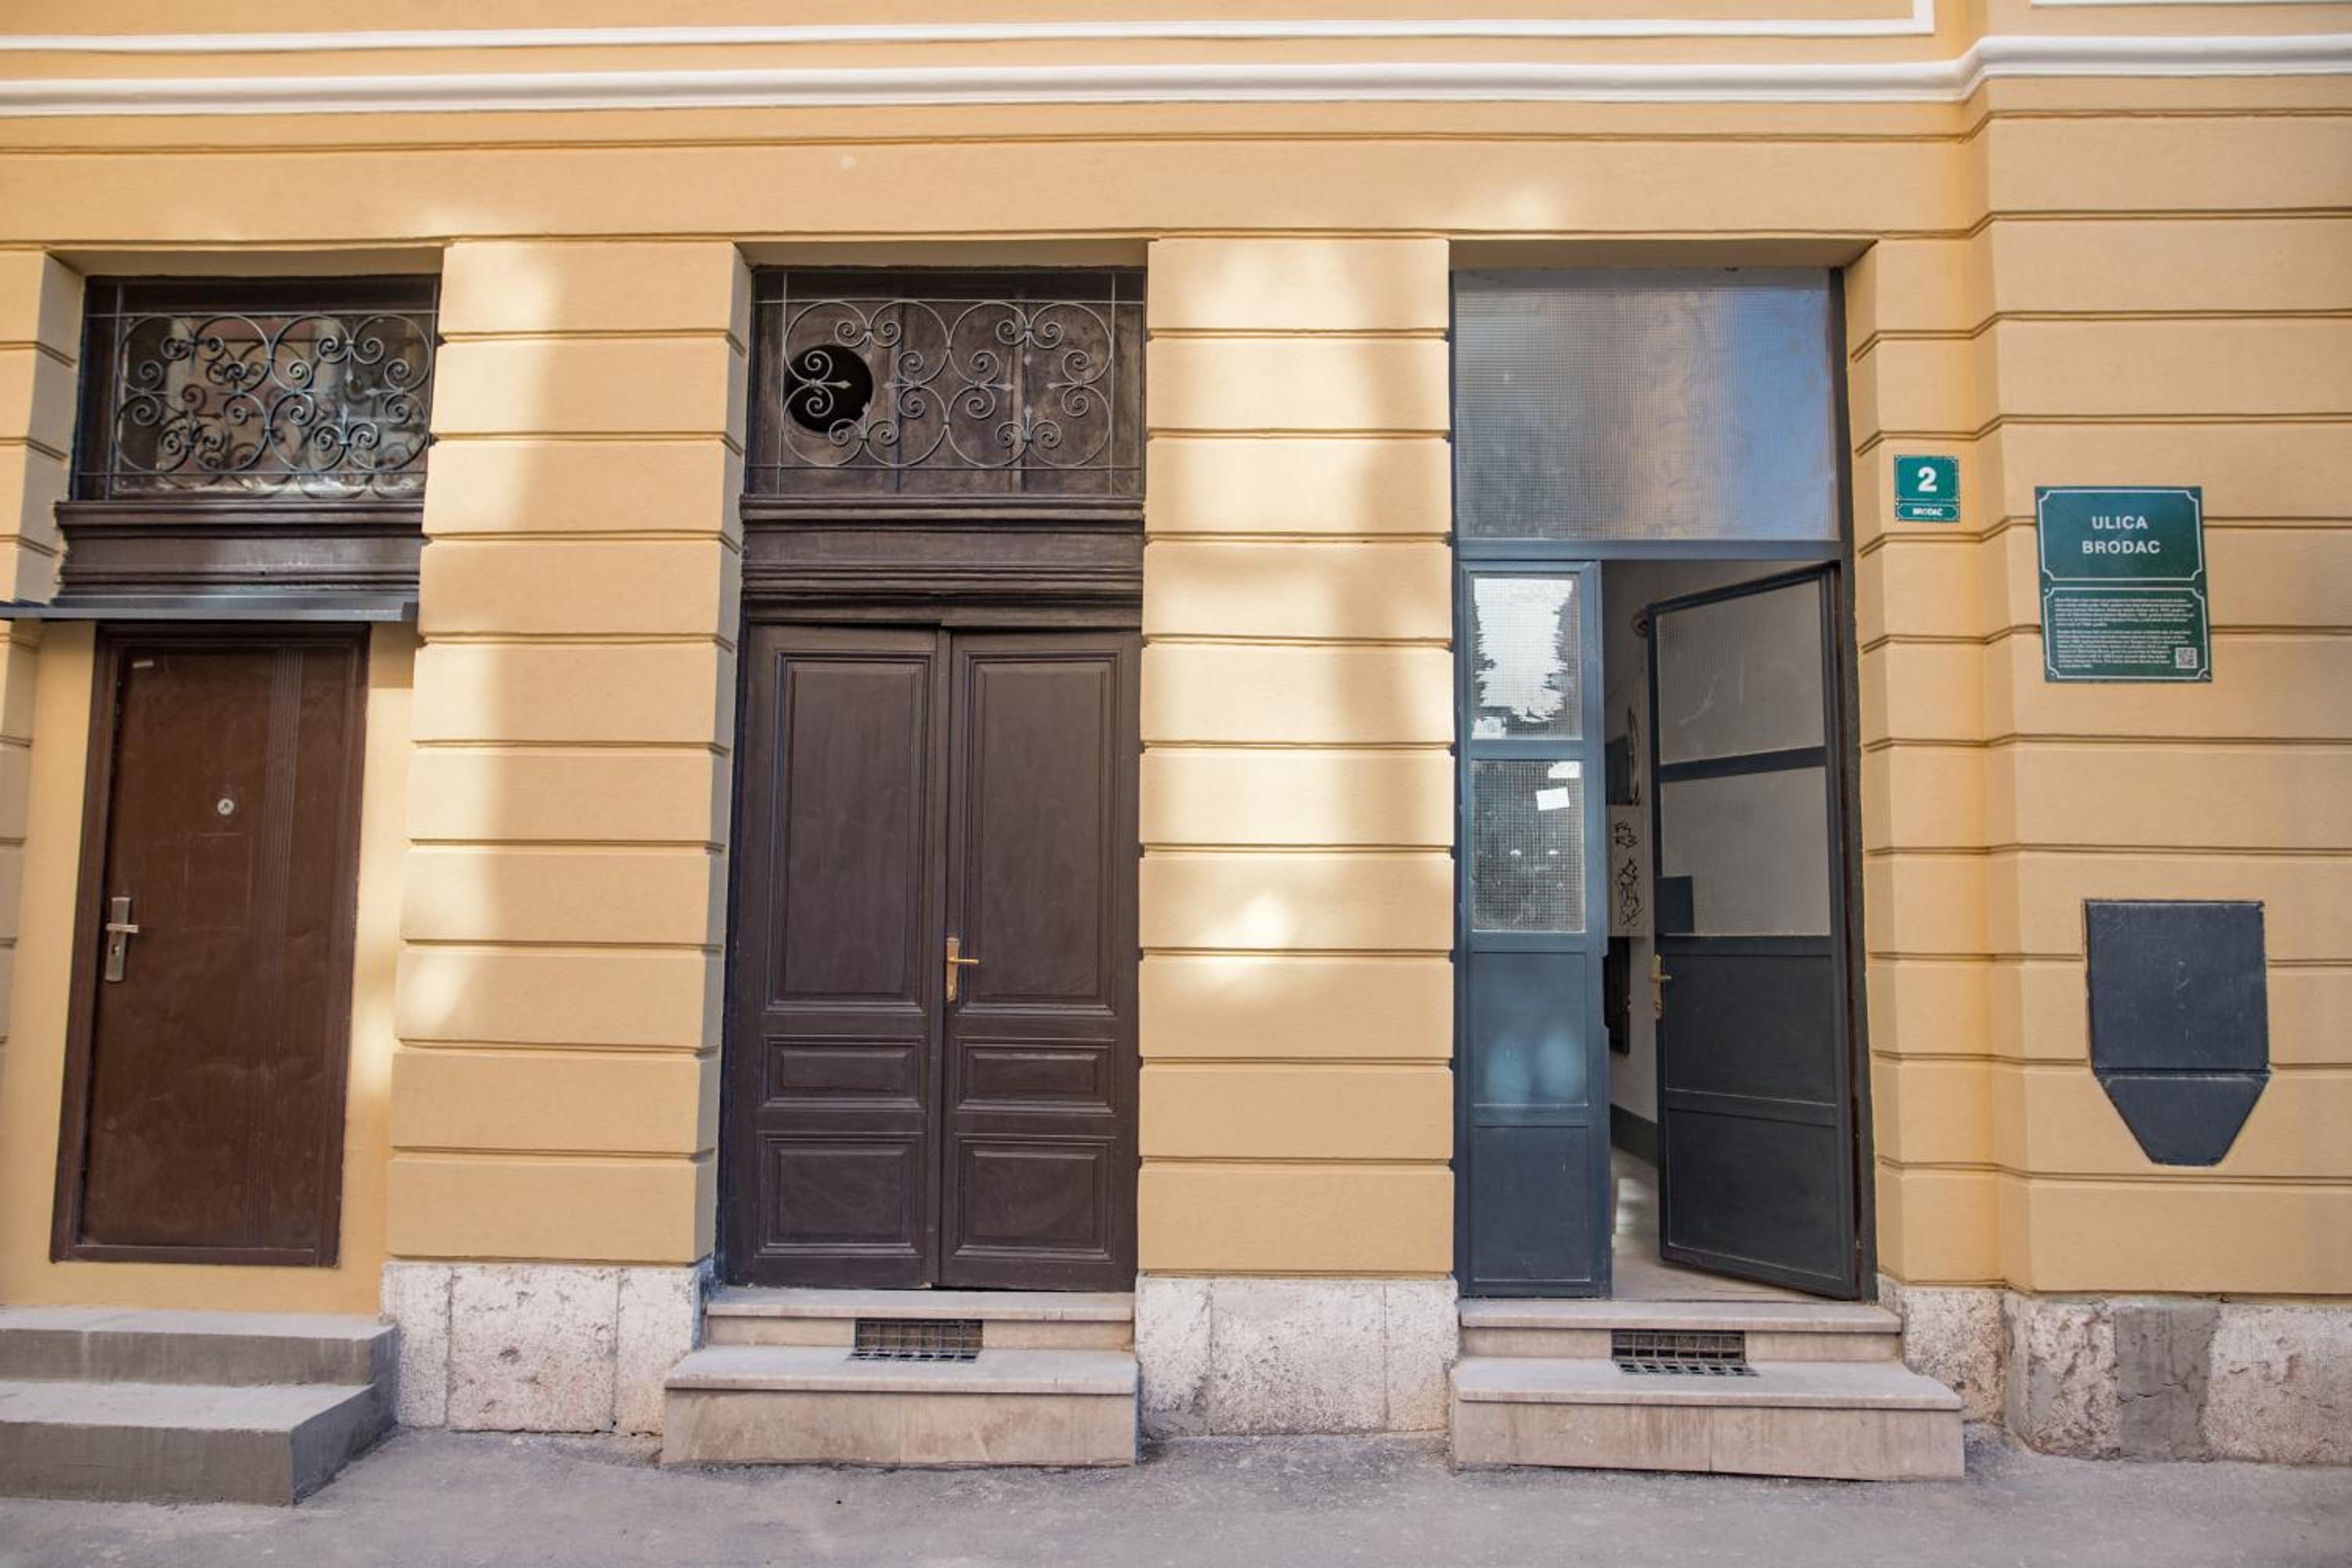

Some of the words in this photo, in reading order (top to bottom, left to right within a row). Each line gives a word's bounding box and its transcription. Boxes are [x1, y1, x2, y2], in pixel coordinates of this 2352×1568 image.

[1918, 466, 1937, 492] 2
[2092, 515, 2148, 529] ULICA
[2082, 540, 2161, 554] BRODAC
